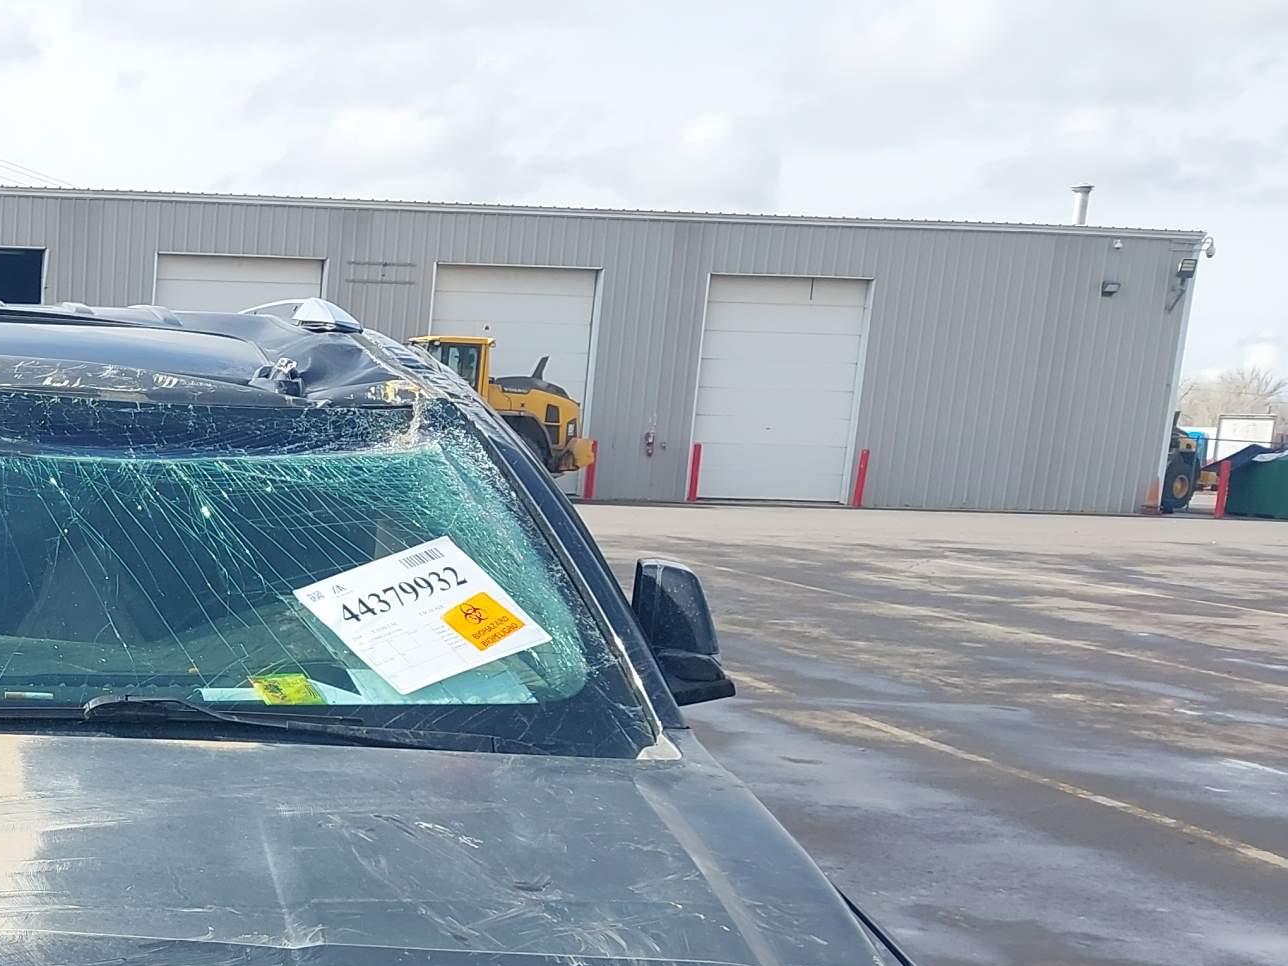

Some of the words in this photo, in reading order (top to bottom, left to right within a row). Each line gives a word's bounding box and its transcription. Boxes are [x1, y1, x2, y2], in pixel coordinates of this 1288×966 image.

[342, 566, 467, 623] 44379932
[472, 615, 510, 640] BIOHAZARD
[481, 622, 519, 647] BIOPELIGRO
